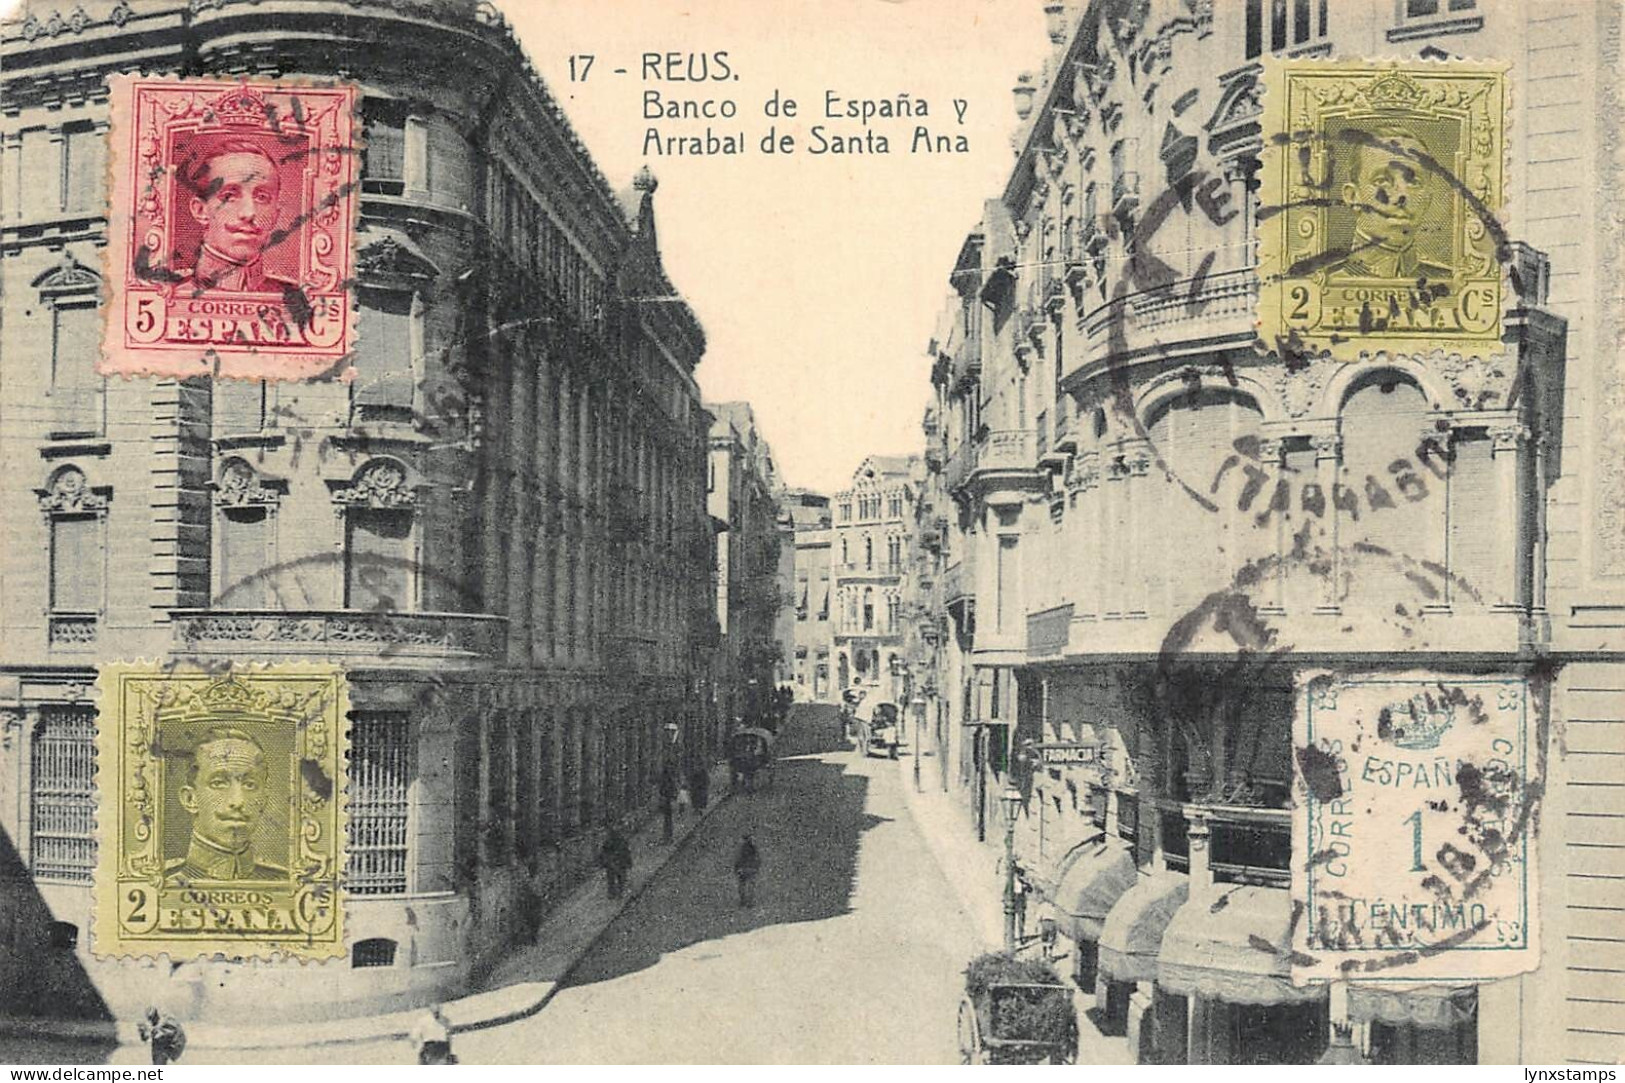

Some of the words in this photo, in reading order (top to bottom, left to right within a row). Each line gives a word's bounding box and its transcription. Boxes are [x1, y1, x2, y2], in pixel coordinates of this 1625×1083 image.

[136, 299, 156, 334] 5
[188, 301, 282, 318] CORREOS
[1290, 286, 1310, 320] 2
[1362, 756, 1474, 789] ESPAÑ
[1402, 810, 1427, 872] 1
[126, 889, 147, 923] 2
[180, 891, 274, 907] CORREOS
